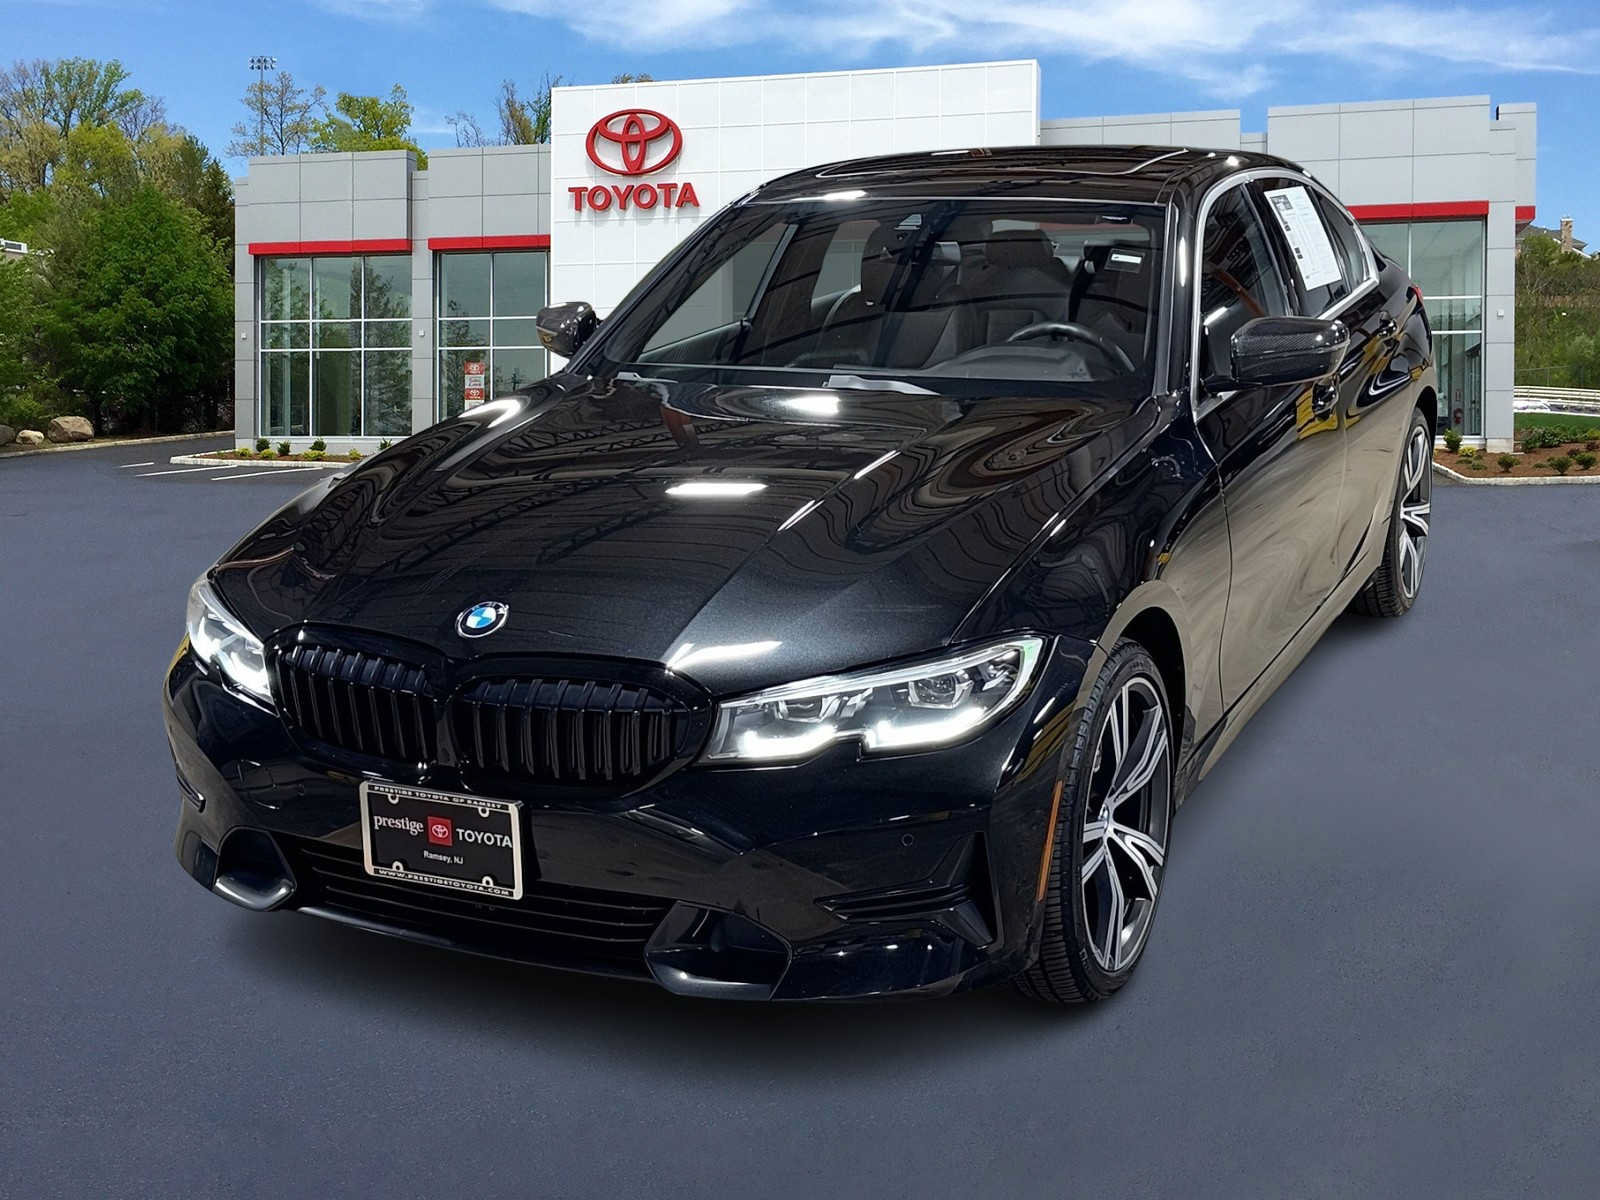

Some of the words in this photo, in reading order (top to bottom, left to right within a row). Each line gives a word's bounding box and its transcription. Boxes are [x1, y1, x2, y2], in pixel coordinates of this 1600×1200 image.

[567, 182, 700, 212] TOYOTA
[415, 791, 449, 801] TOYOTA
[373, 815, 424, 836] prestige
[456, 828, 513, 848] TOYOTA
[423, 850, 453, 864] Ramsey,
[453, 855, 464, 865] NJ
